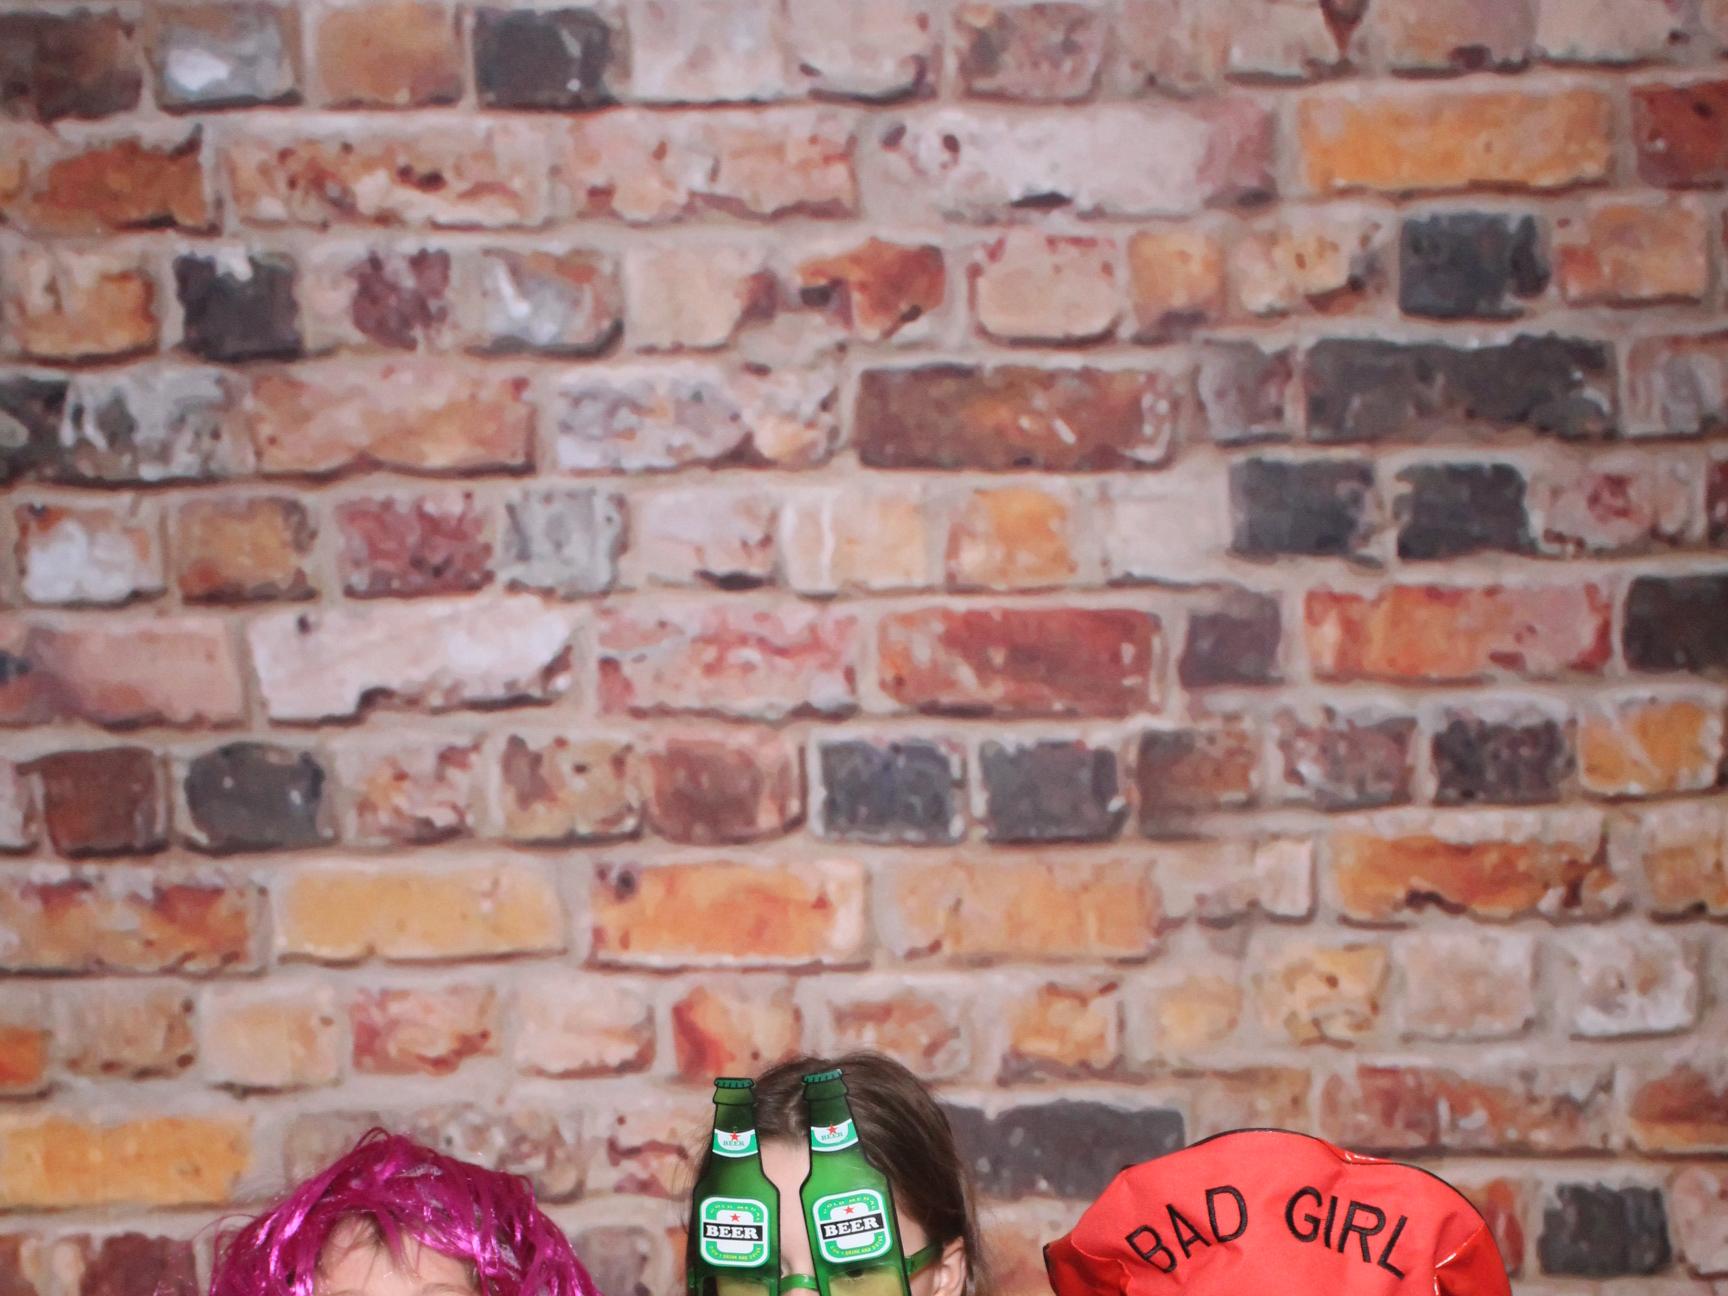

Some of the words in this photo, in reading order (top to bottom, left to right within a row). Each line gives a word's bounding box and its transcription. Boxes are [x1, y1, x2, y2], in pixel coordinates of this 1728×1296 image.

[705, 1224, 759, 1240] BEER
[823, 1216, 880, 1238] BEER
[1125, 1185, 1248, 1274] BAD
[1285, 1185, 1410, 1280] GIRL
